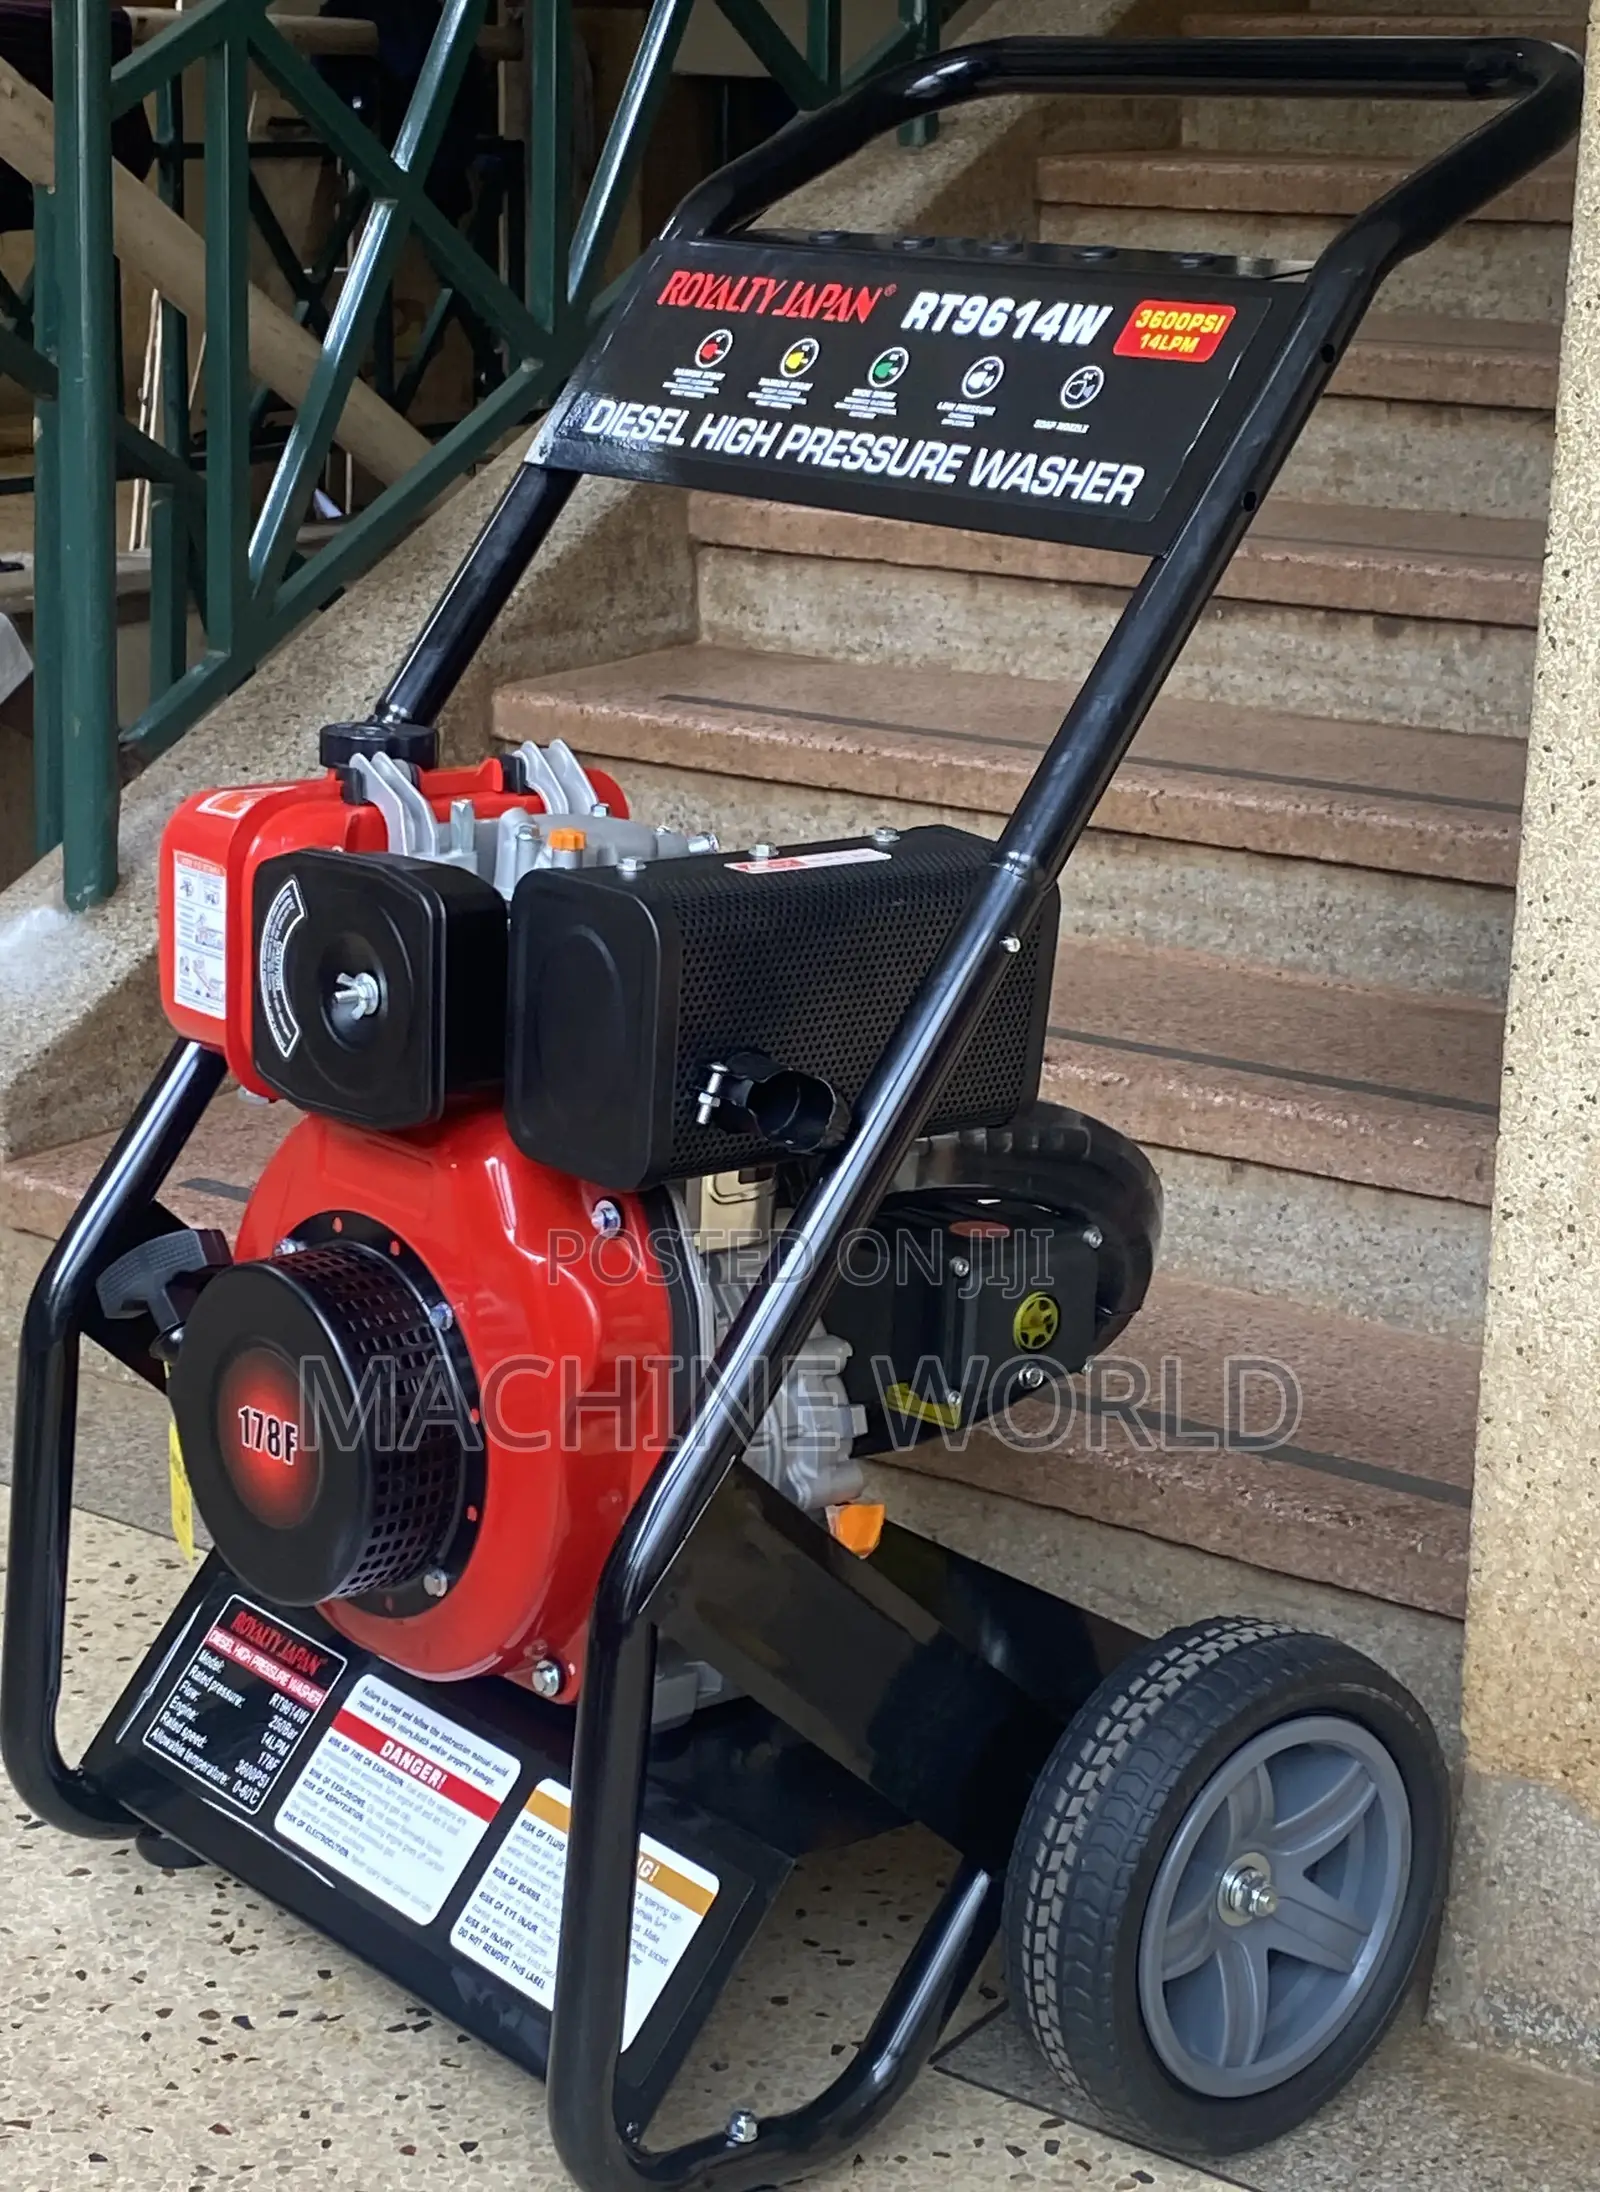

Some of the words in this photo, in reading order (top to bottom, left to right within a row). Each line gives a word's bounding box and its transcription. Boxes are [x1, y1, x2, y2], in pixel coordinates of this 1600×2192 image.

[657, 270, 787, 315] ROYALTY
[900, 291, 1114, 346] RT9614W
[1135, 309, 1226, 335] 3600PSI
[1140, 333, 1200, 353] 14LPM
[582, 399, 690, 446] DIESEL
[691, 412, 783, 458] HIGH
[775, 423, 972, 485] PRESSURE
[968, 447, 1144, 507] WASHER
[238, 1405, 298, 1466] 178F
[230, 1611, 283, 1652] ROYALTY
[188, 1665, 213, 1686] Rated
[207, 1680, 245, 1709] pressure:
[208, 1630, 235, 1651] DIESEL
[232, 1645, 253, 1662] HIGH
[249, 1656, 290, 1685] PRESSURE
[286, 1678, 322, 1704] WASHER
[159, 1712, 184, 1732] Rated
[234, 1760, 270, 1787] 3600PSI
[256, 1752, 279, 1771] 178F
[259, 1731, 289, 1755] 14LPM
[378, 1739, 448, 1790] DANGER!
